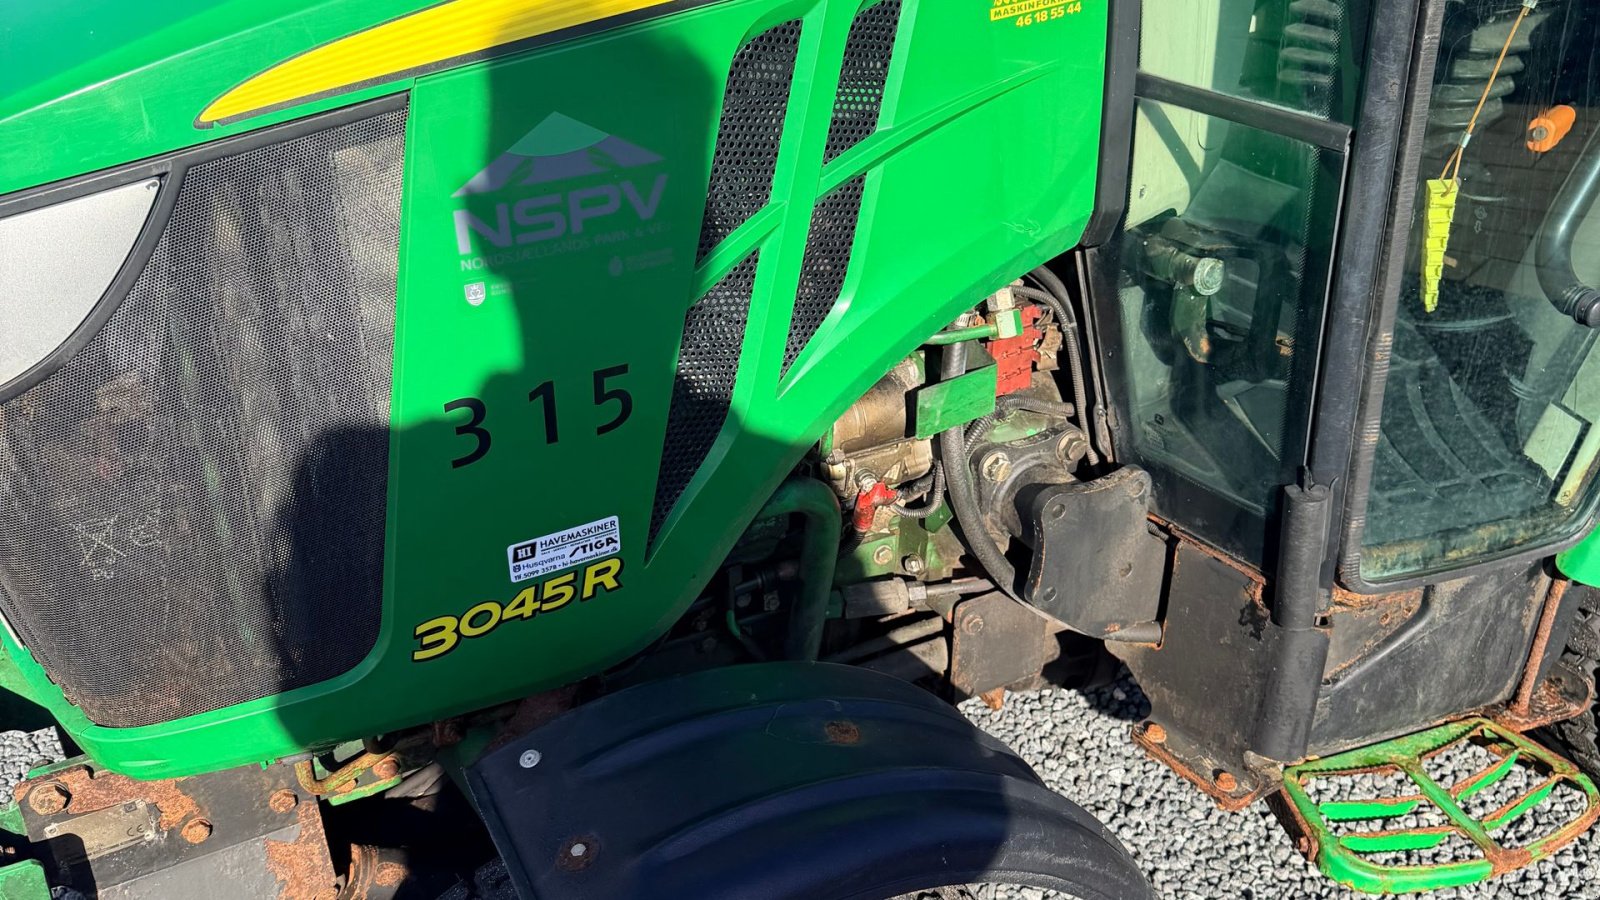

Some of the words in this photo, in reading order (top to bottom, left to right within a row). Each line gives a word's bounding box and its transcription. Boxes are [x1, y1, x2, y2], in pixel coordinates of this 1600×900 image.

[1016, 14, 1032, 27] 46
[1034, 10, 1048, 23] 18
[1050, 6, 1064, 19] 55
[1067, 2, 1081, 14] 44
[453, 174, 668, 247] NSPV
[540, 520, 616, 549] HAVEMASKINER
[569, 537, 618, 558] STIGA
[522, 553, 566, 570] Husqvarna
